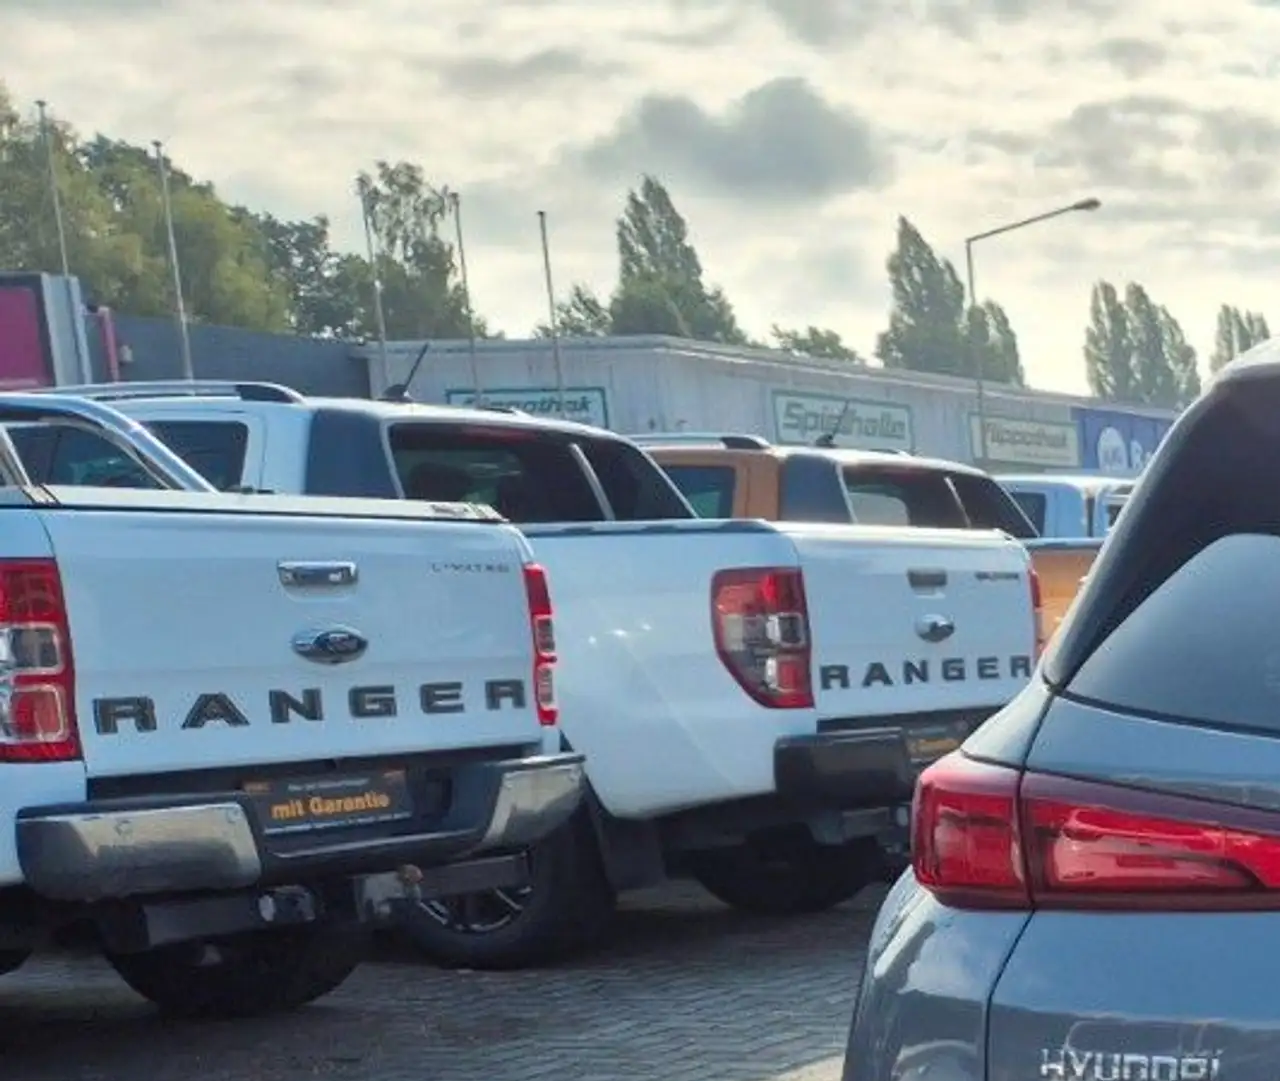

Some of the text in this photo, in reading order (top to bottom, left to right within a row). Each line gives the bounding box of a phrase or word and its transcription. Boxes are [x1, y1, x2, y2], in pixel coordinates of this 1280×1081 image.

[820, 655, 1031, 690] RANGER
[93, 679, 527, 735] RANGER
[271, 791, 390, 819] mit Garantie
